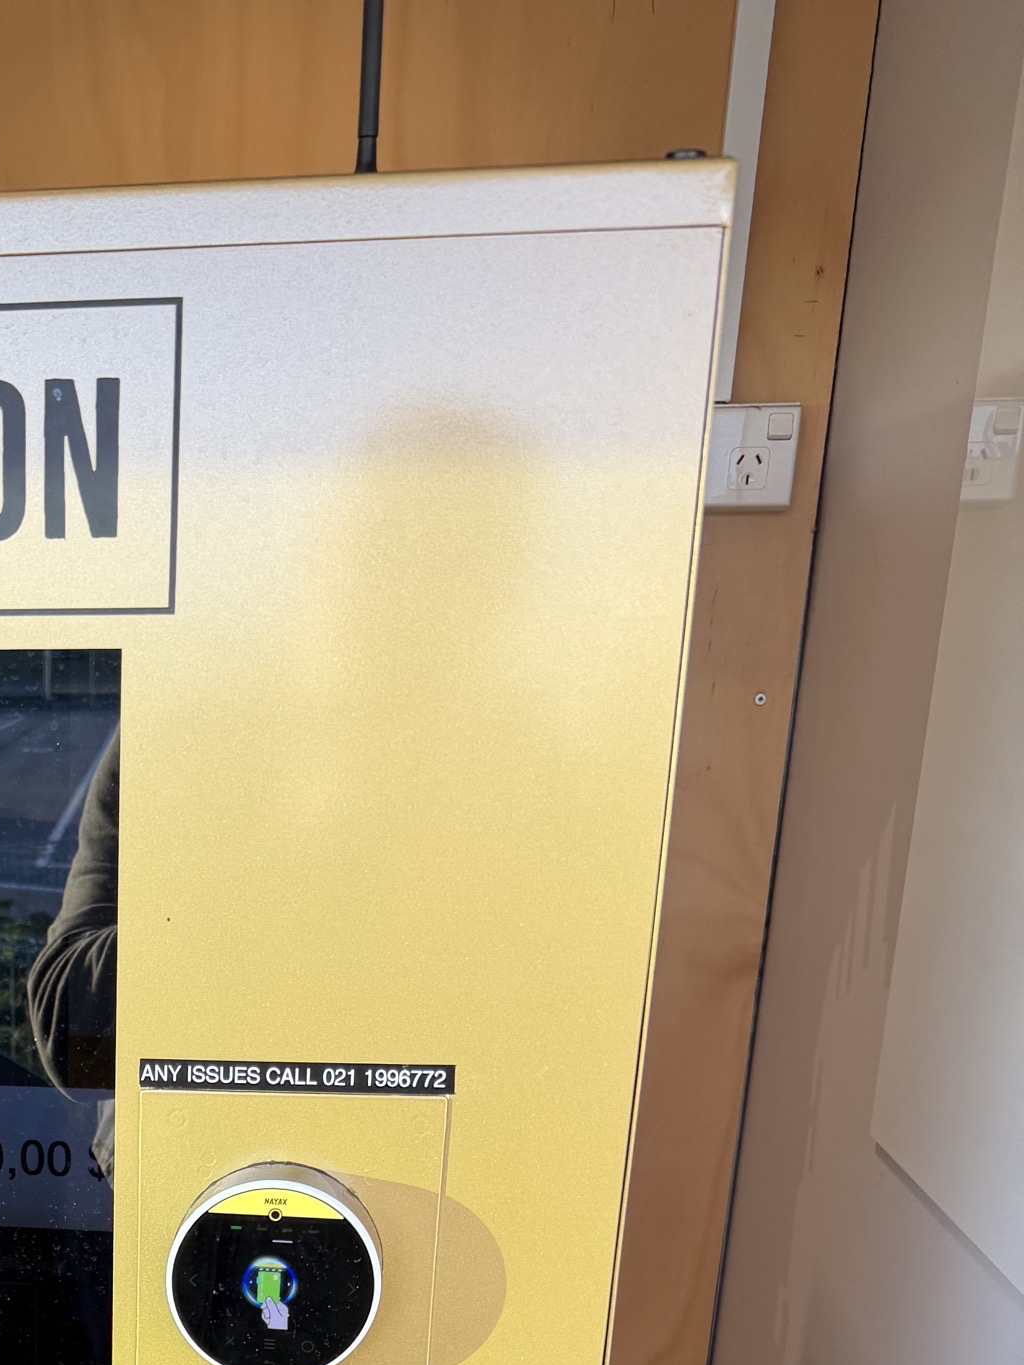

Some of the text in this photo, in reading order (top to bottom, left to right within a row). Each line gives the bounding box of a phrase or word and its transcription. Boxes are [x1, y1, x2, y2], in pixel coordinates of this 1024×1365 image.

[141, 1064, 447, 1089] ANY ISSUES CALL 021 1996772
[264, 1198, 288, 1206] NAYAX
